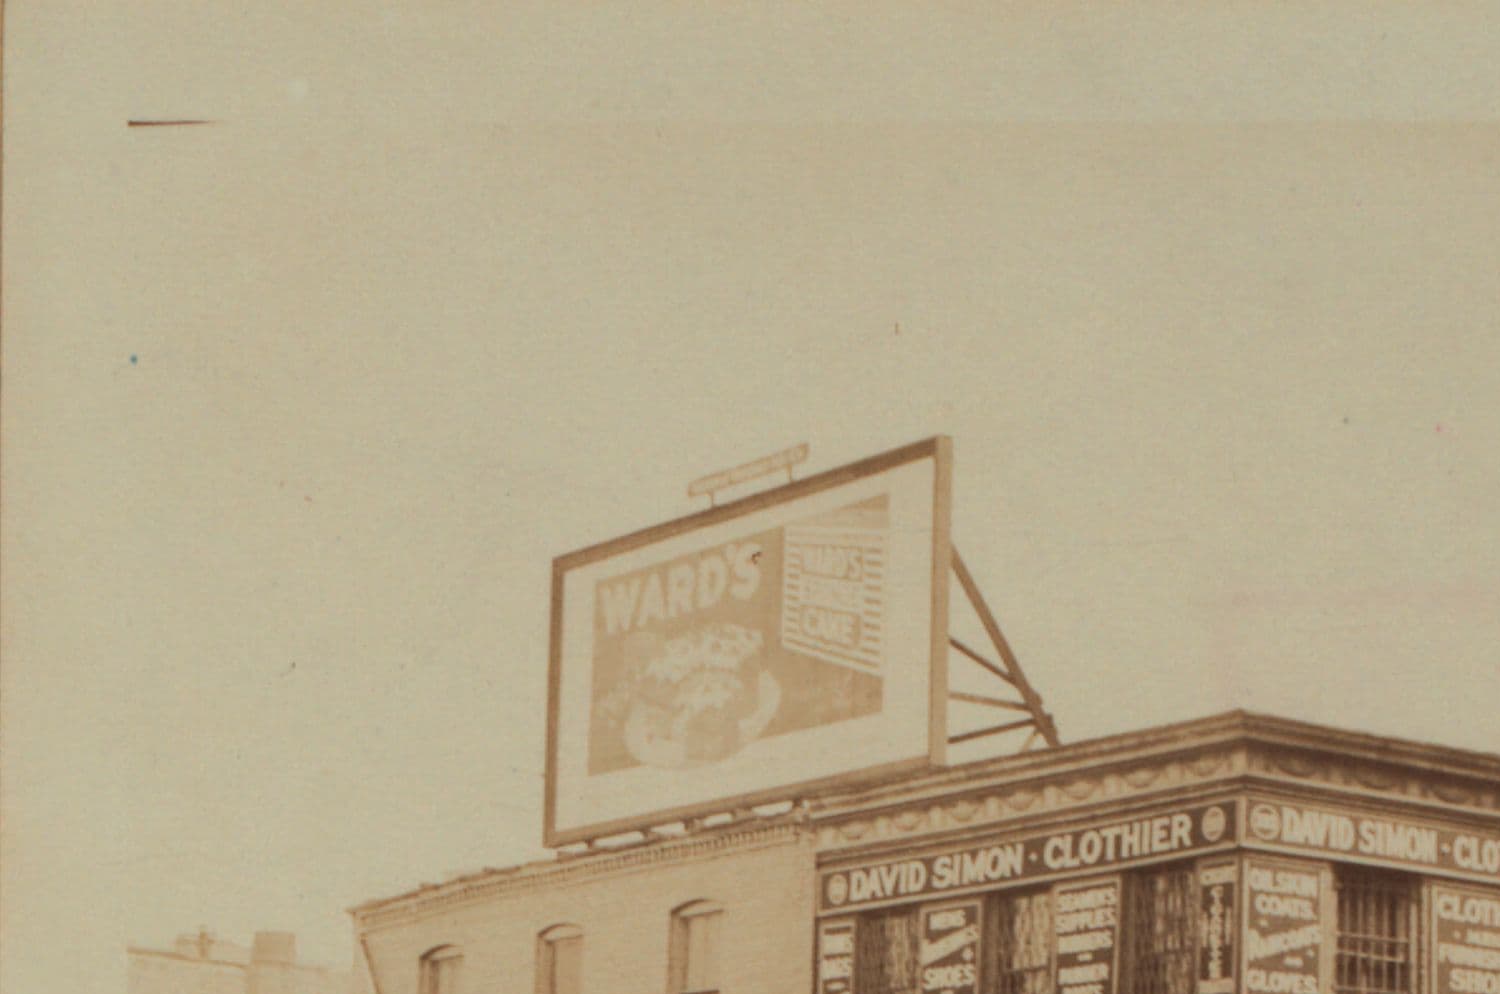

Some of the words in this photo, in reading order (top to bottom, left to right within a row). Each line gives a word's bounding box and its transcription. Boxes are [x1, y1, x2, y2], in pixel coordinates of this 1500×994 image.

[600, 541, 760, 636] WARD'S
[849, 860, 926, 901] DAVID
[931, 843, 1024, 889] SIMON
[1044, 813, 1192, 868] CLOTHIER
[1280, 806, 1355, 851] DAVID
[1359, 820, 1438, 864] SIMON
